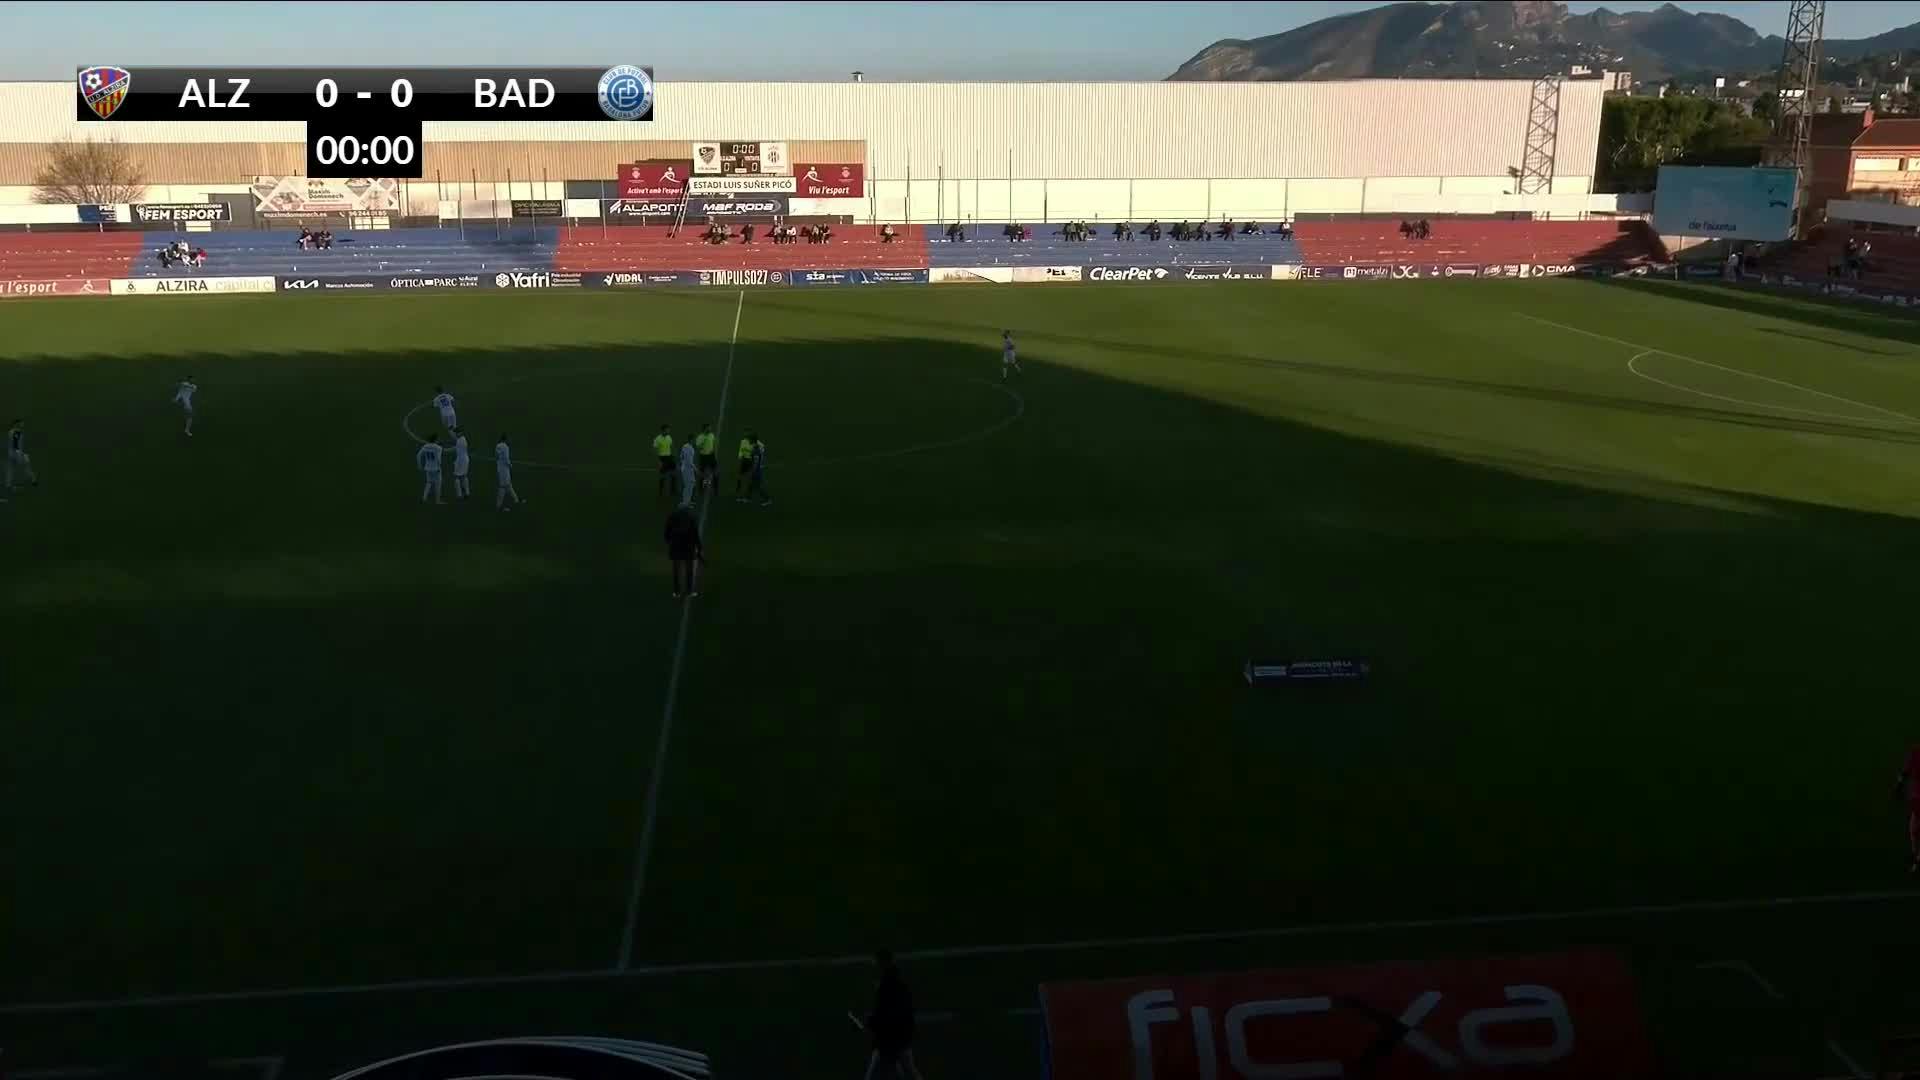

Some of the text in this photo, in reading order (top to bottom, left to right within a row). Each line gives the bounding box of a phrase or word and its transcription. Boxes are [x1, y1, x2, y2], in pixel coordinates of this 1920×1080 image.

[732, 144, 755, 154] 0:00
[693, 180, 792, 189] ESTADI LUIS SUÑER PICÓ
[662, 188, 683, 196] l'esport
[808, 186, 850, 196] Viu l'esport
[622, 204, 685, 212] ALAPONT
[145, 209, 223, 220] FEM ESPORT
[1090, 267, 1154, 281] ClearPet
[1546, 265, 1577, 273] CMA
[390, 277, 425, 288] ÓPTICA
[434, 278, 457, 287] PARC
[509, 272, 550, 288] Yafri
[614, 273, 643, 283] VIDAL
[8, 281, 57, 295] l'esport
[155, 280, 209, 293] ALZIRA
[284, 279, 319, 289] KIA
